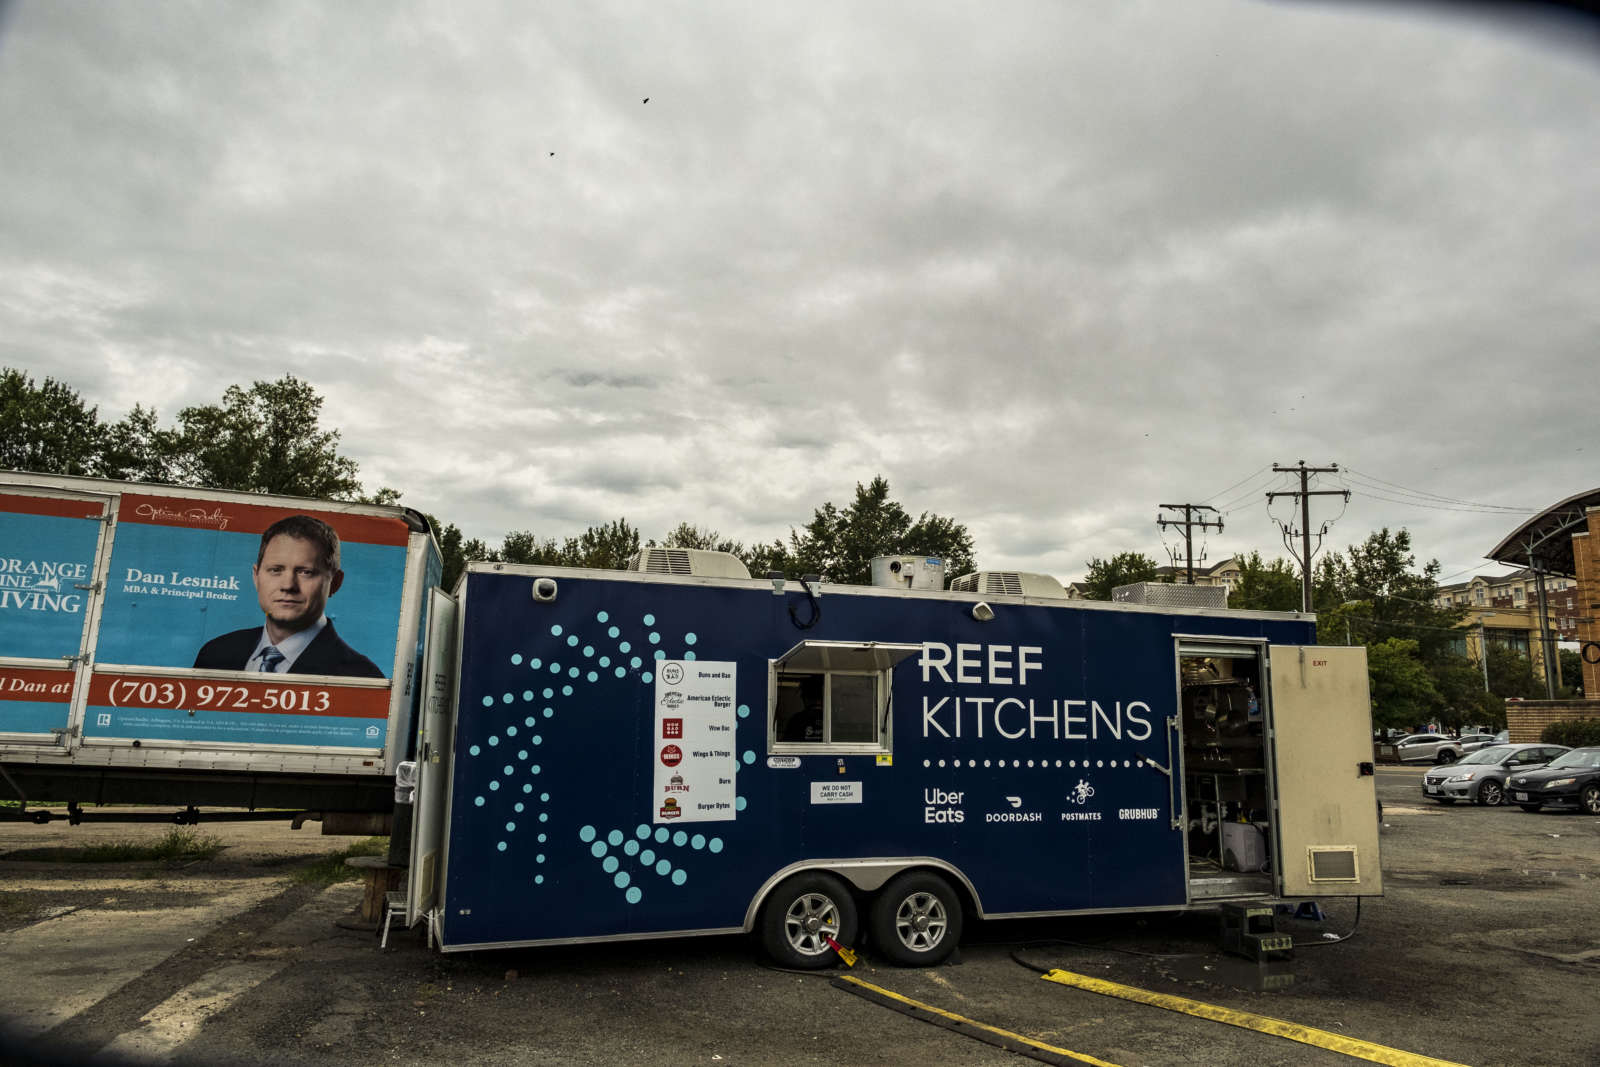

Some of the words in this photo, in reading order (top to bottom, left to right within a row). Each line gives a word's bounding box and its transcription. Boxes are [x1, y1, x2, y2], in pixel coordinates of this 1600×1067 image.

[126, 568, 165, 584] Dan
[170, 571, 240, 590] Lesniak
[123, 585, 148, 594] MBA
[150, 587, 159, 595] &
[161, 587, 204, 599] Principal
[206, 591, 238, 601] Broker
[918, 641, 1043, 686] REEF
[8, 678, 47, 693] Dan
[51, 682, 71, 694] at
[108, 678, 187, 709] (703)
[196, 685, 331, 712] 972-5013
[923, 695, 1152, 741] KITCHENS
[692, 751, 709, 759] Wings
[714, 750, 731, 758] Things
[924, 787, 965, 805] Uber
[697, 803, 715, 811] Burger
[924, 806, 965, 824] Eats
[1118, 808, 1158, 820] GRUBHUB
[985, 812, 1043, 823] DOORDASH
[1061, 812, 1102, 821] POSTMATES
